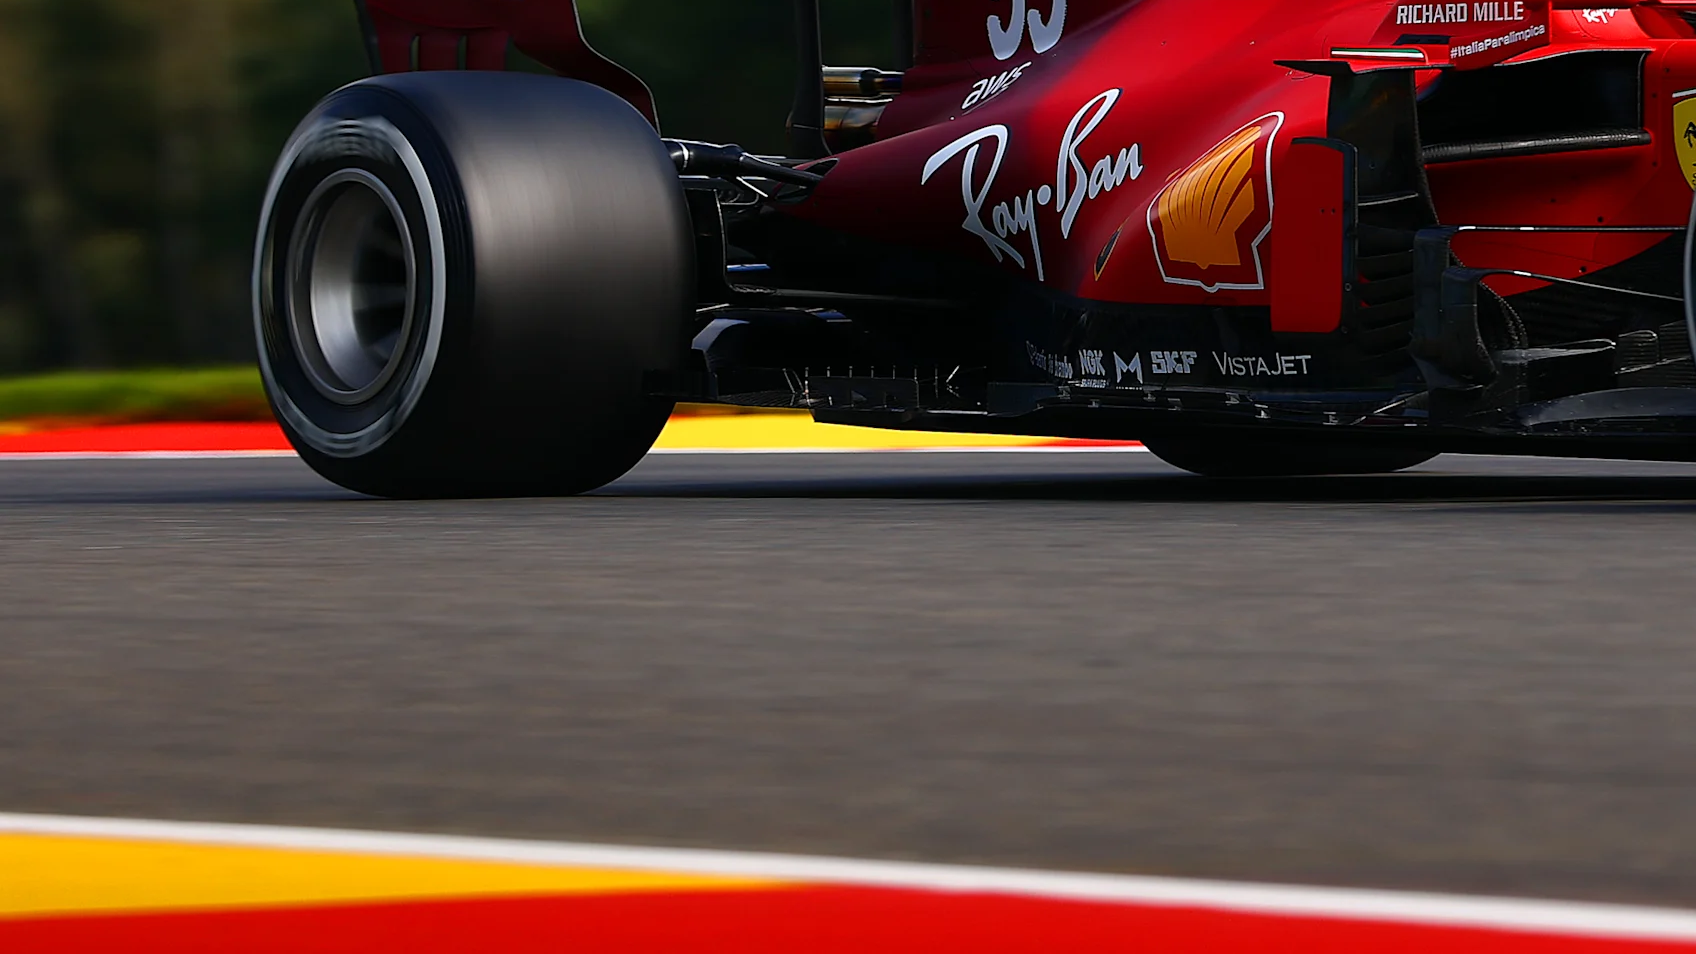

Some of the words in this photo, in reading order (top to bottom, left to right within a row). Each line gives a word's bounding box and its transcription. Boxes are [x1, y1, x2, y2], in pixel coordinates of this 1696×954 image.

[1396, 3, 1468, 25] RICHARD
[1473, 0, 1525, 22] MILLE
[961, 60, 1032, 110] aws
[1078, 348, 1106, 376] NGK
[1150, 350, 1198, 374] SKF
